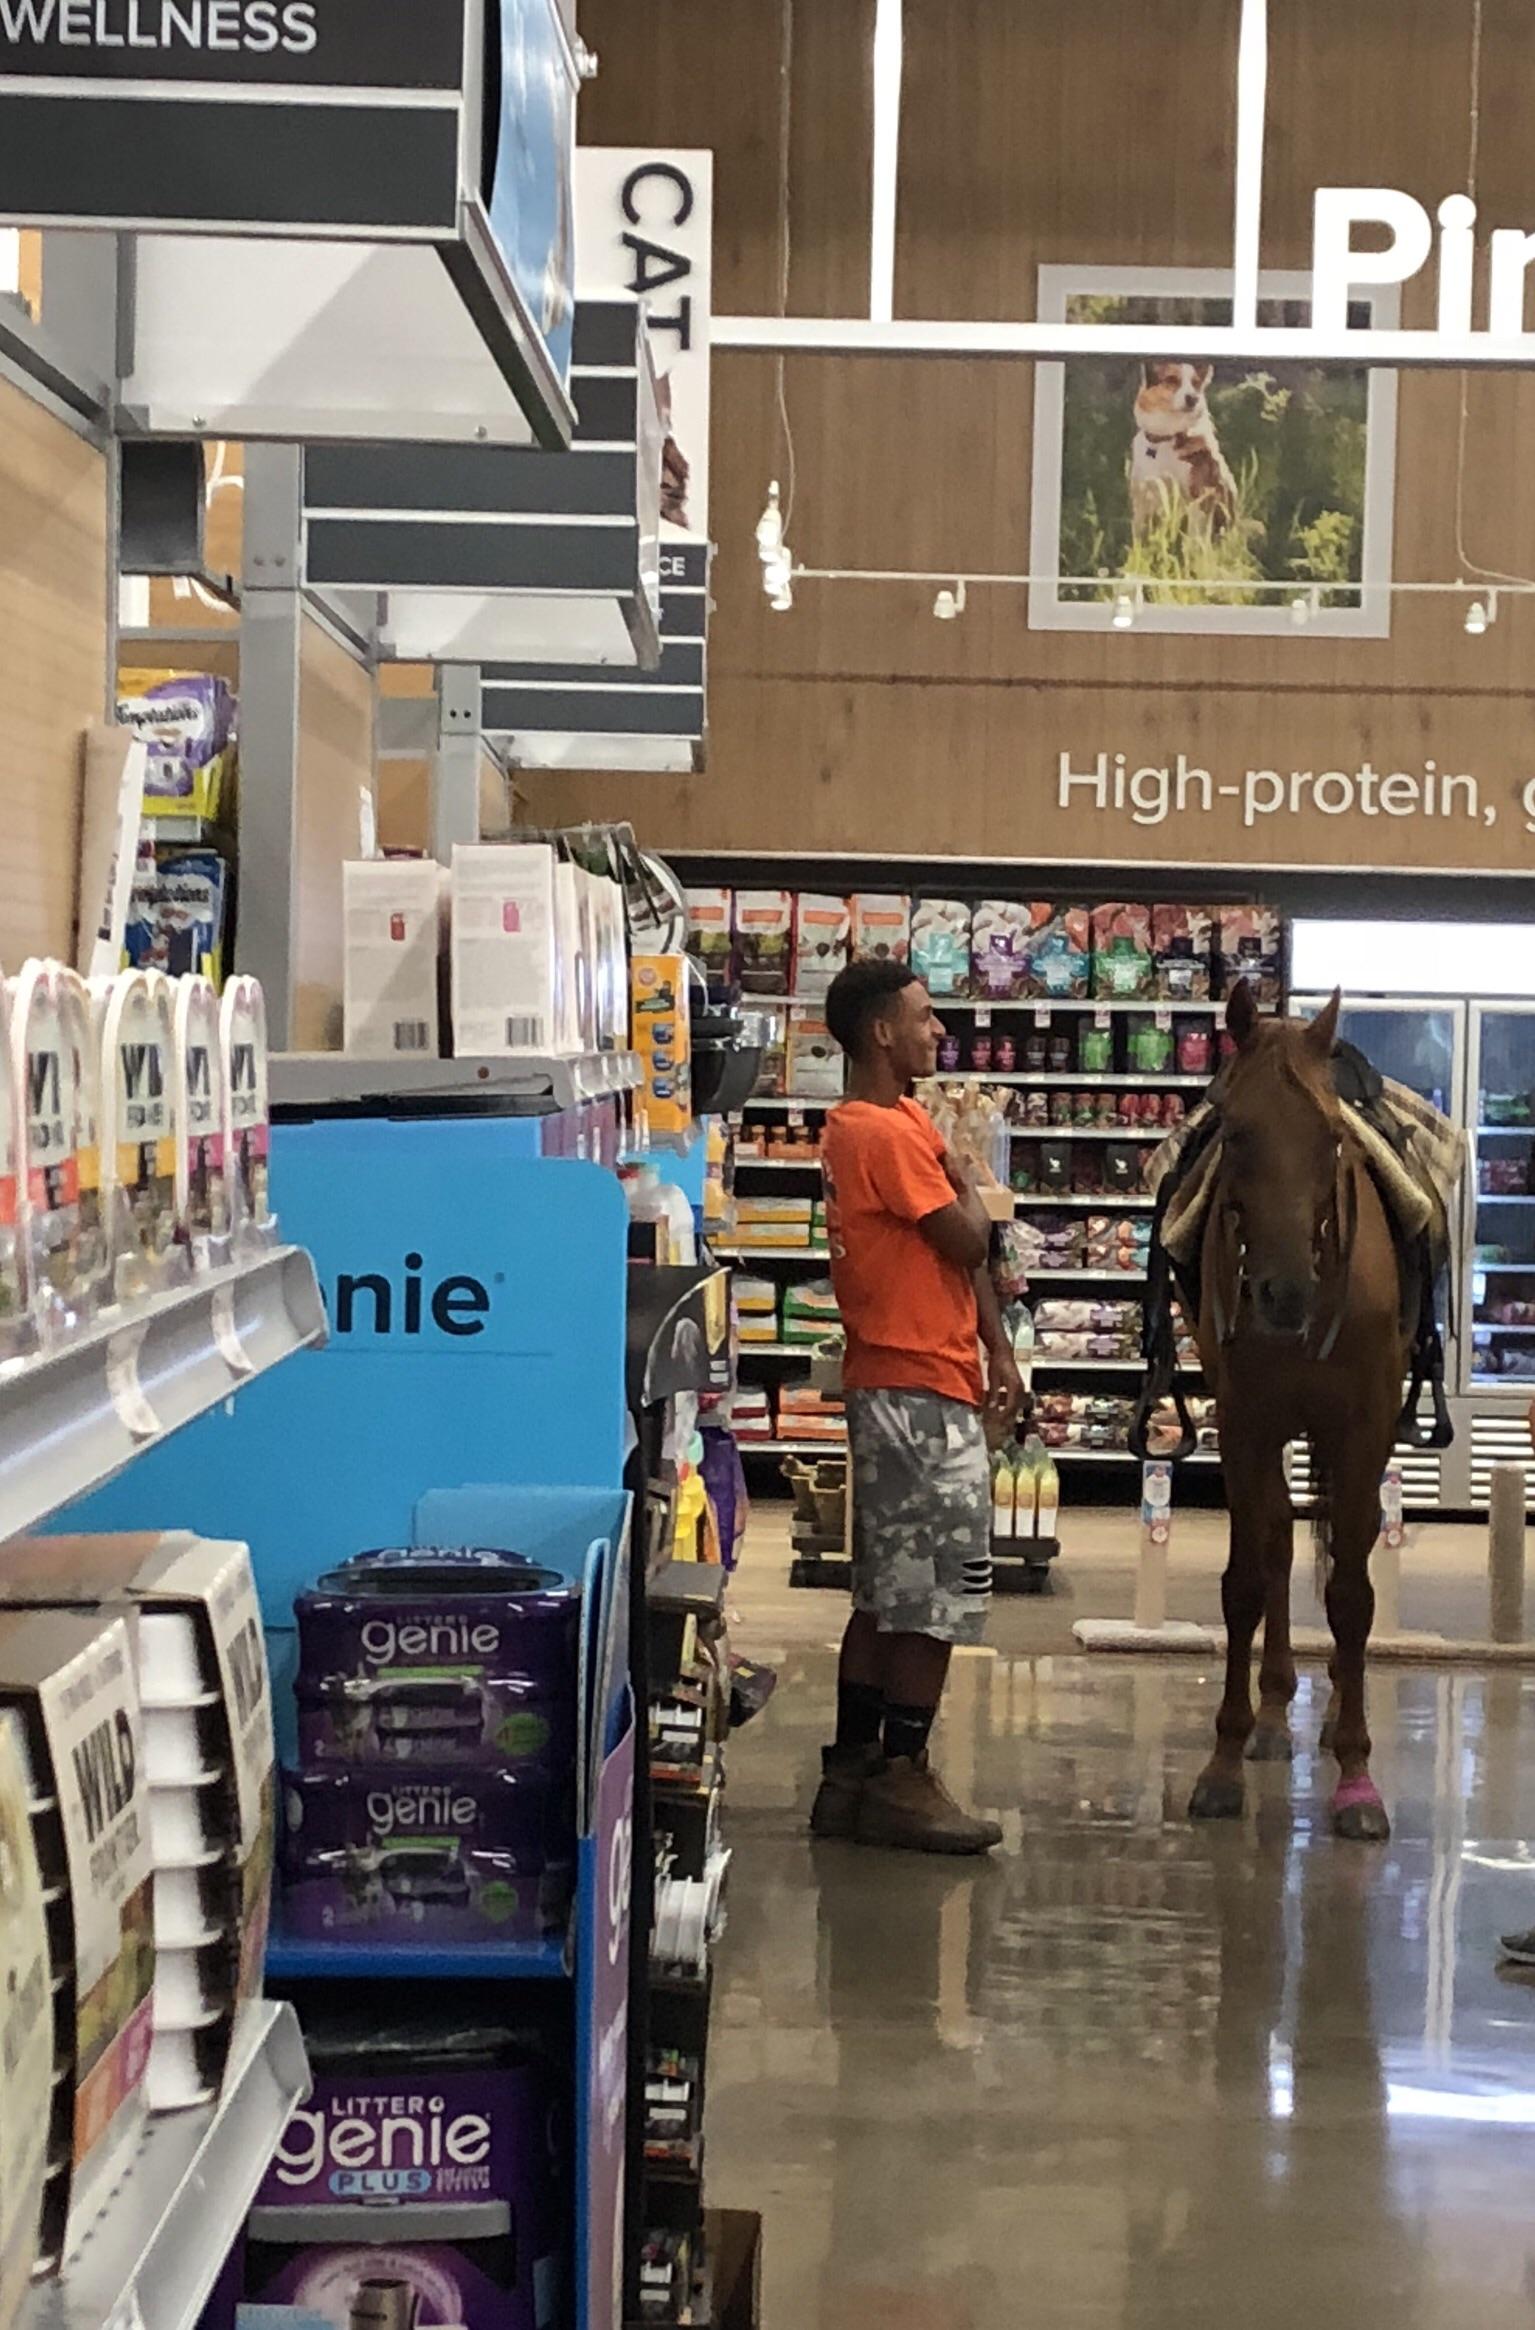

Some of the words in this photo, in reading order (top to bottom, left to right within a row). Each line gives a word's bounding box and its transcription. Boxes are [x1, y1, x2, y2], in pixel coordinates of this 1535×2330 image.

[1, 0, 318, 52] WELLNESS
[621, 162, 694, 350] CAT
[1058, 752, 1497, 826] High-protein,
[360, 1615, 500, 1665] genie
[366, 1787, 478, 1836] genie
[332, 2096, 424, 2117] LITTER
[274, 2098, 492, 2186] genie
[338, 2171, 423, 2192] PLUS
